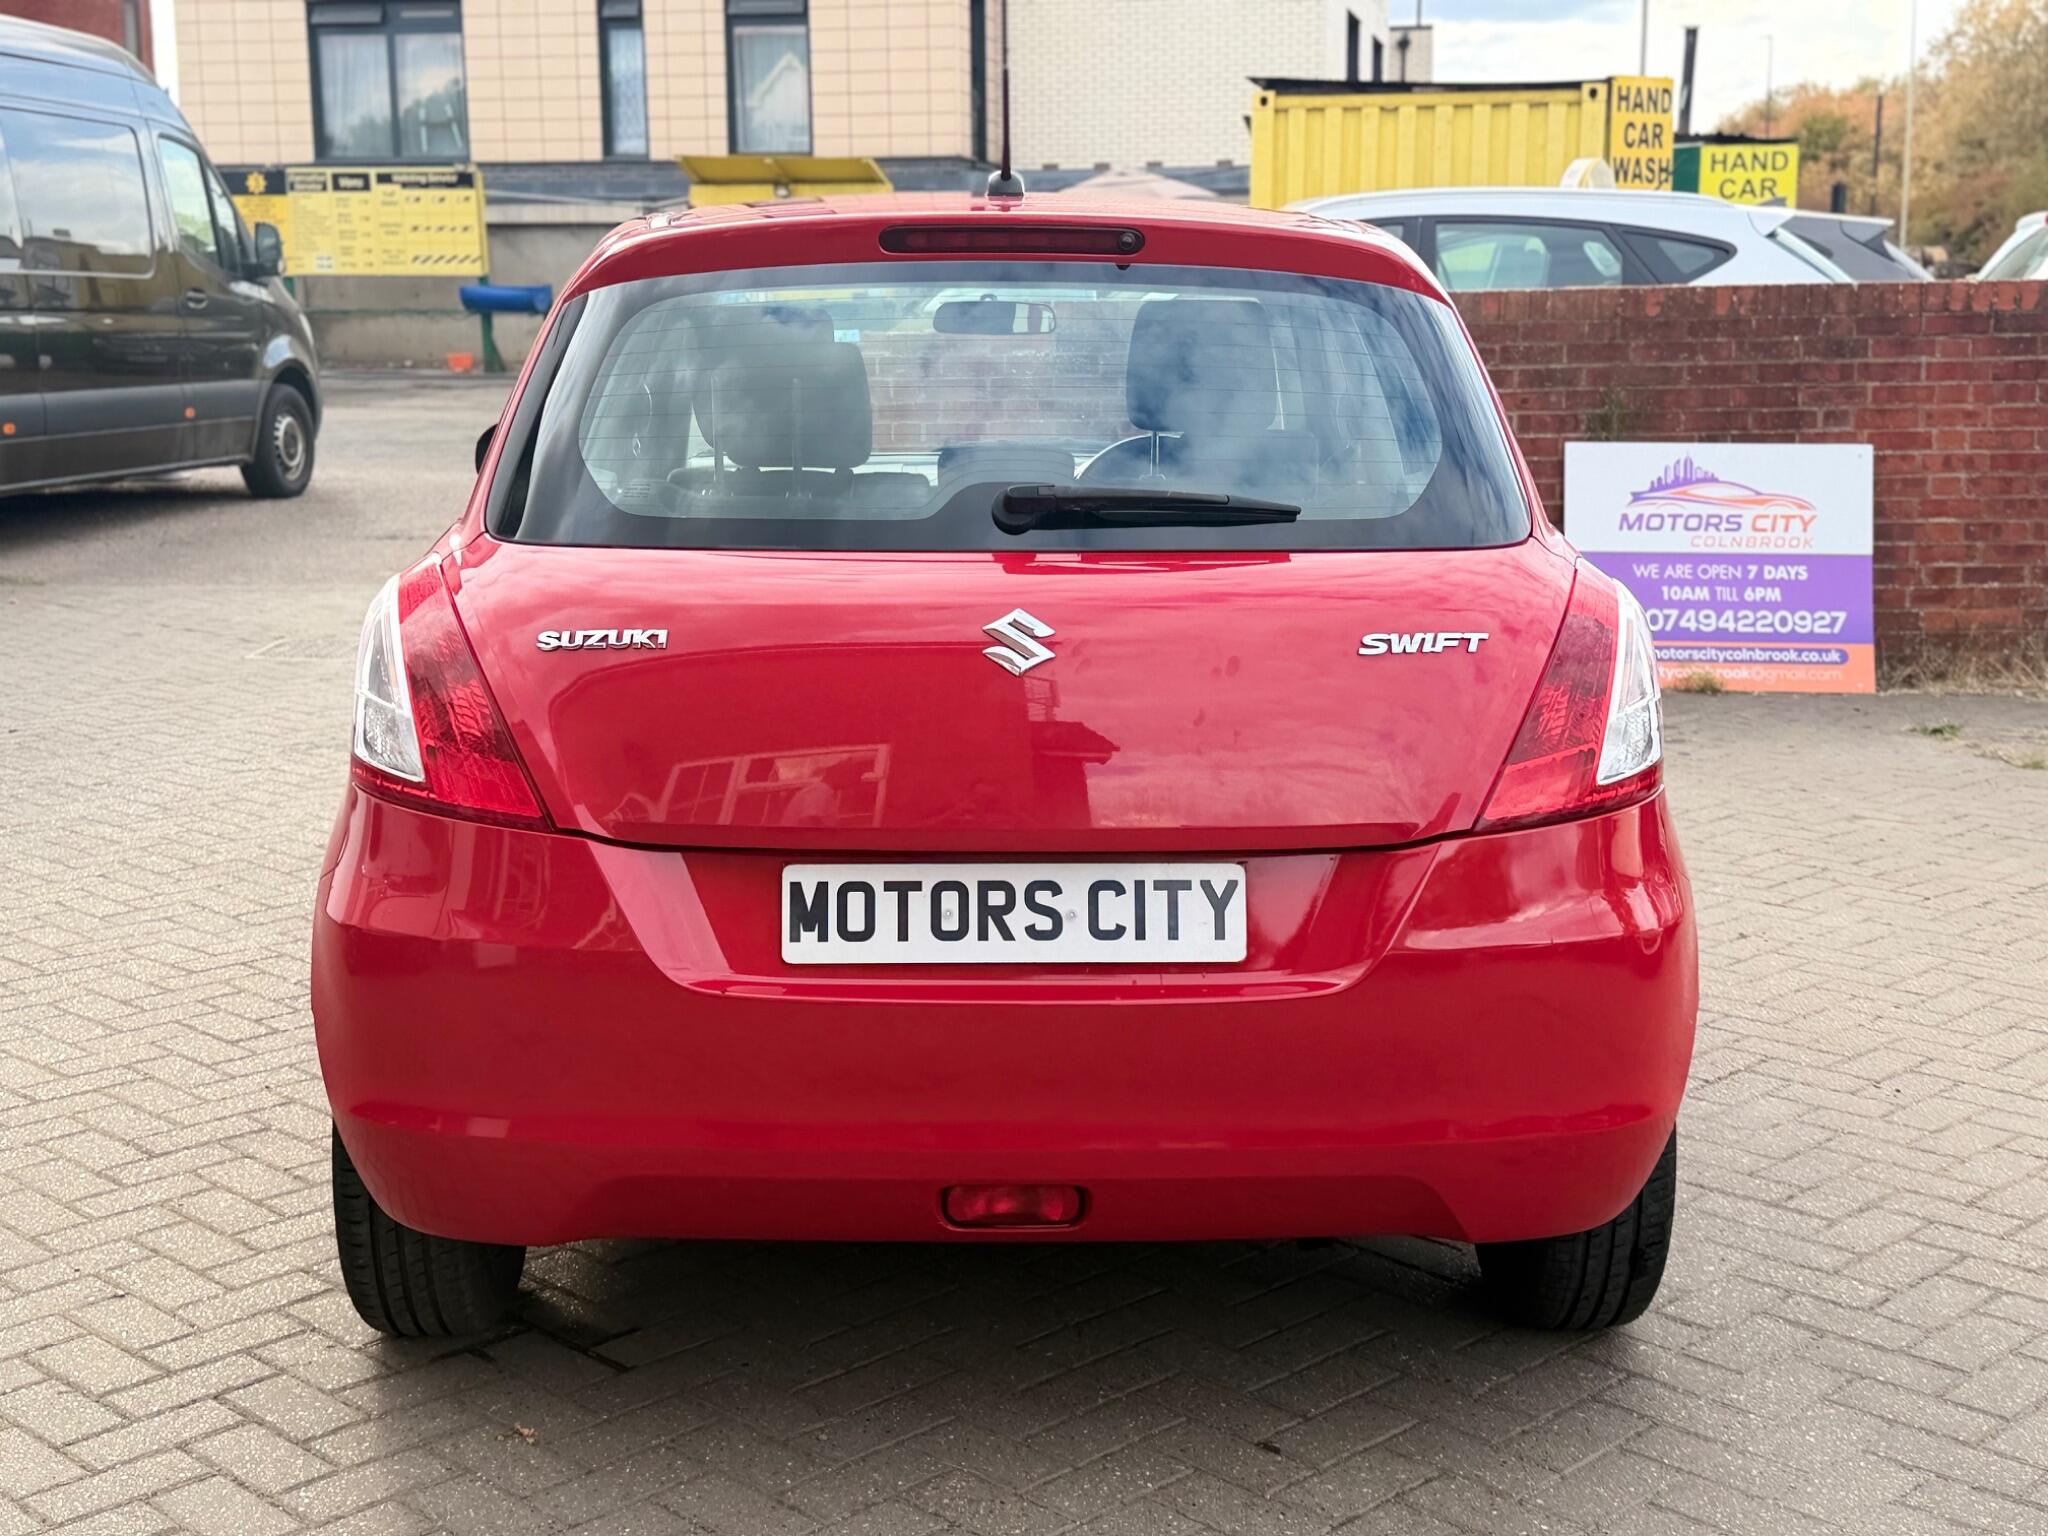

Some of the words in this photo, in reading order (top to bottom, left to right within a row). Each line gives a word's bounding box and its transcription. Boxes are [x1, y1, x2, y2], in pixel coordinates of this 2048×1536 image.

[1616, 86, 1672, 114] HAND
[1623, 121, 1663, 149] CAR
[1613, 157, 1670, 184] WASH
[1710, 151, 1788, 173] HAND
[1719, 178, 1777, 199] CAR
[1619, 513, 1743, 532] MOTORS
[1751, 514, 1818, 533] CITY
[1690, 535, 1814, 549] COLNBROOK
[1632, 563, 1659, 579] WE
[1664, 564, 1693, 579] ARE
[1697, 564, 1742, 580] OPEN
[1747, 565, 1759, 580] 7
[1763, 565, 1808, 581] DAYS
[1661, 586, 1710, 601] 10AM
[1715, 586, 1739, 602] TILL
[1744, 587, 1782, 602] 6PM
[1649, 609, 1847, 634] 07494220927
[536, 629, 668, 651] SUZUKI
[1358, 632, 1489, 655] SWIFT
[789, 880, 1063, 943] MOTORS
[1088, 879, 1239, 942] CITY
